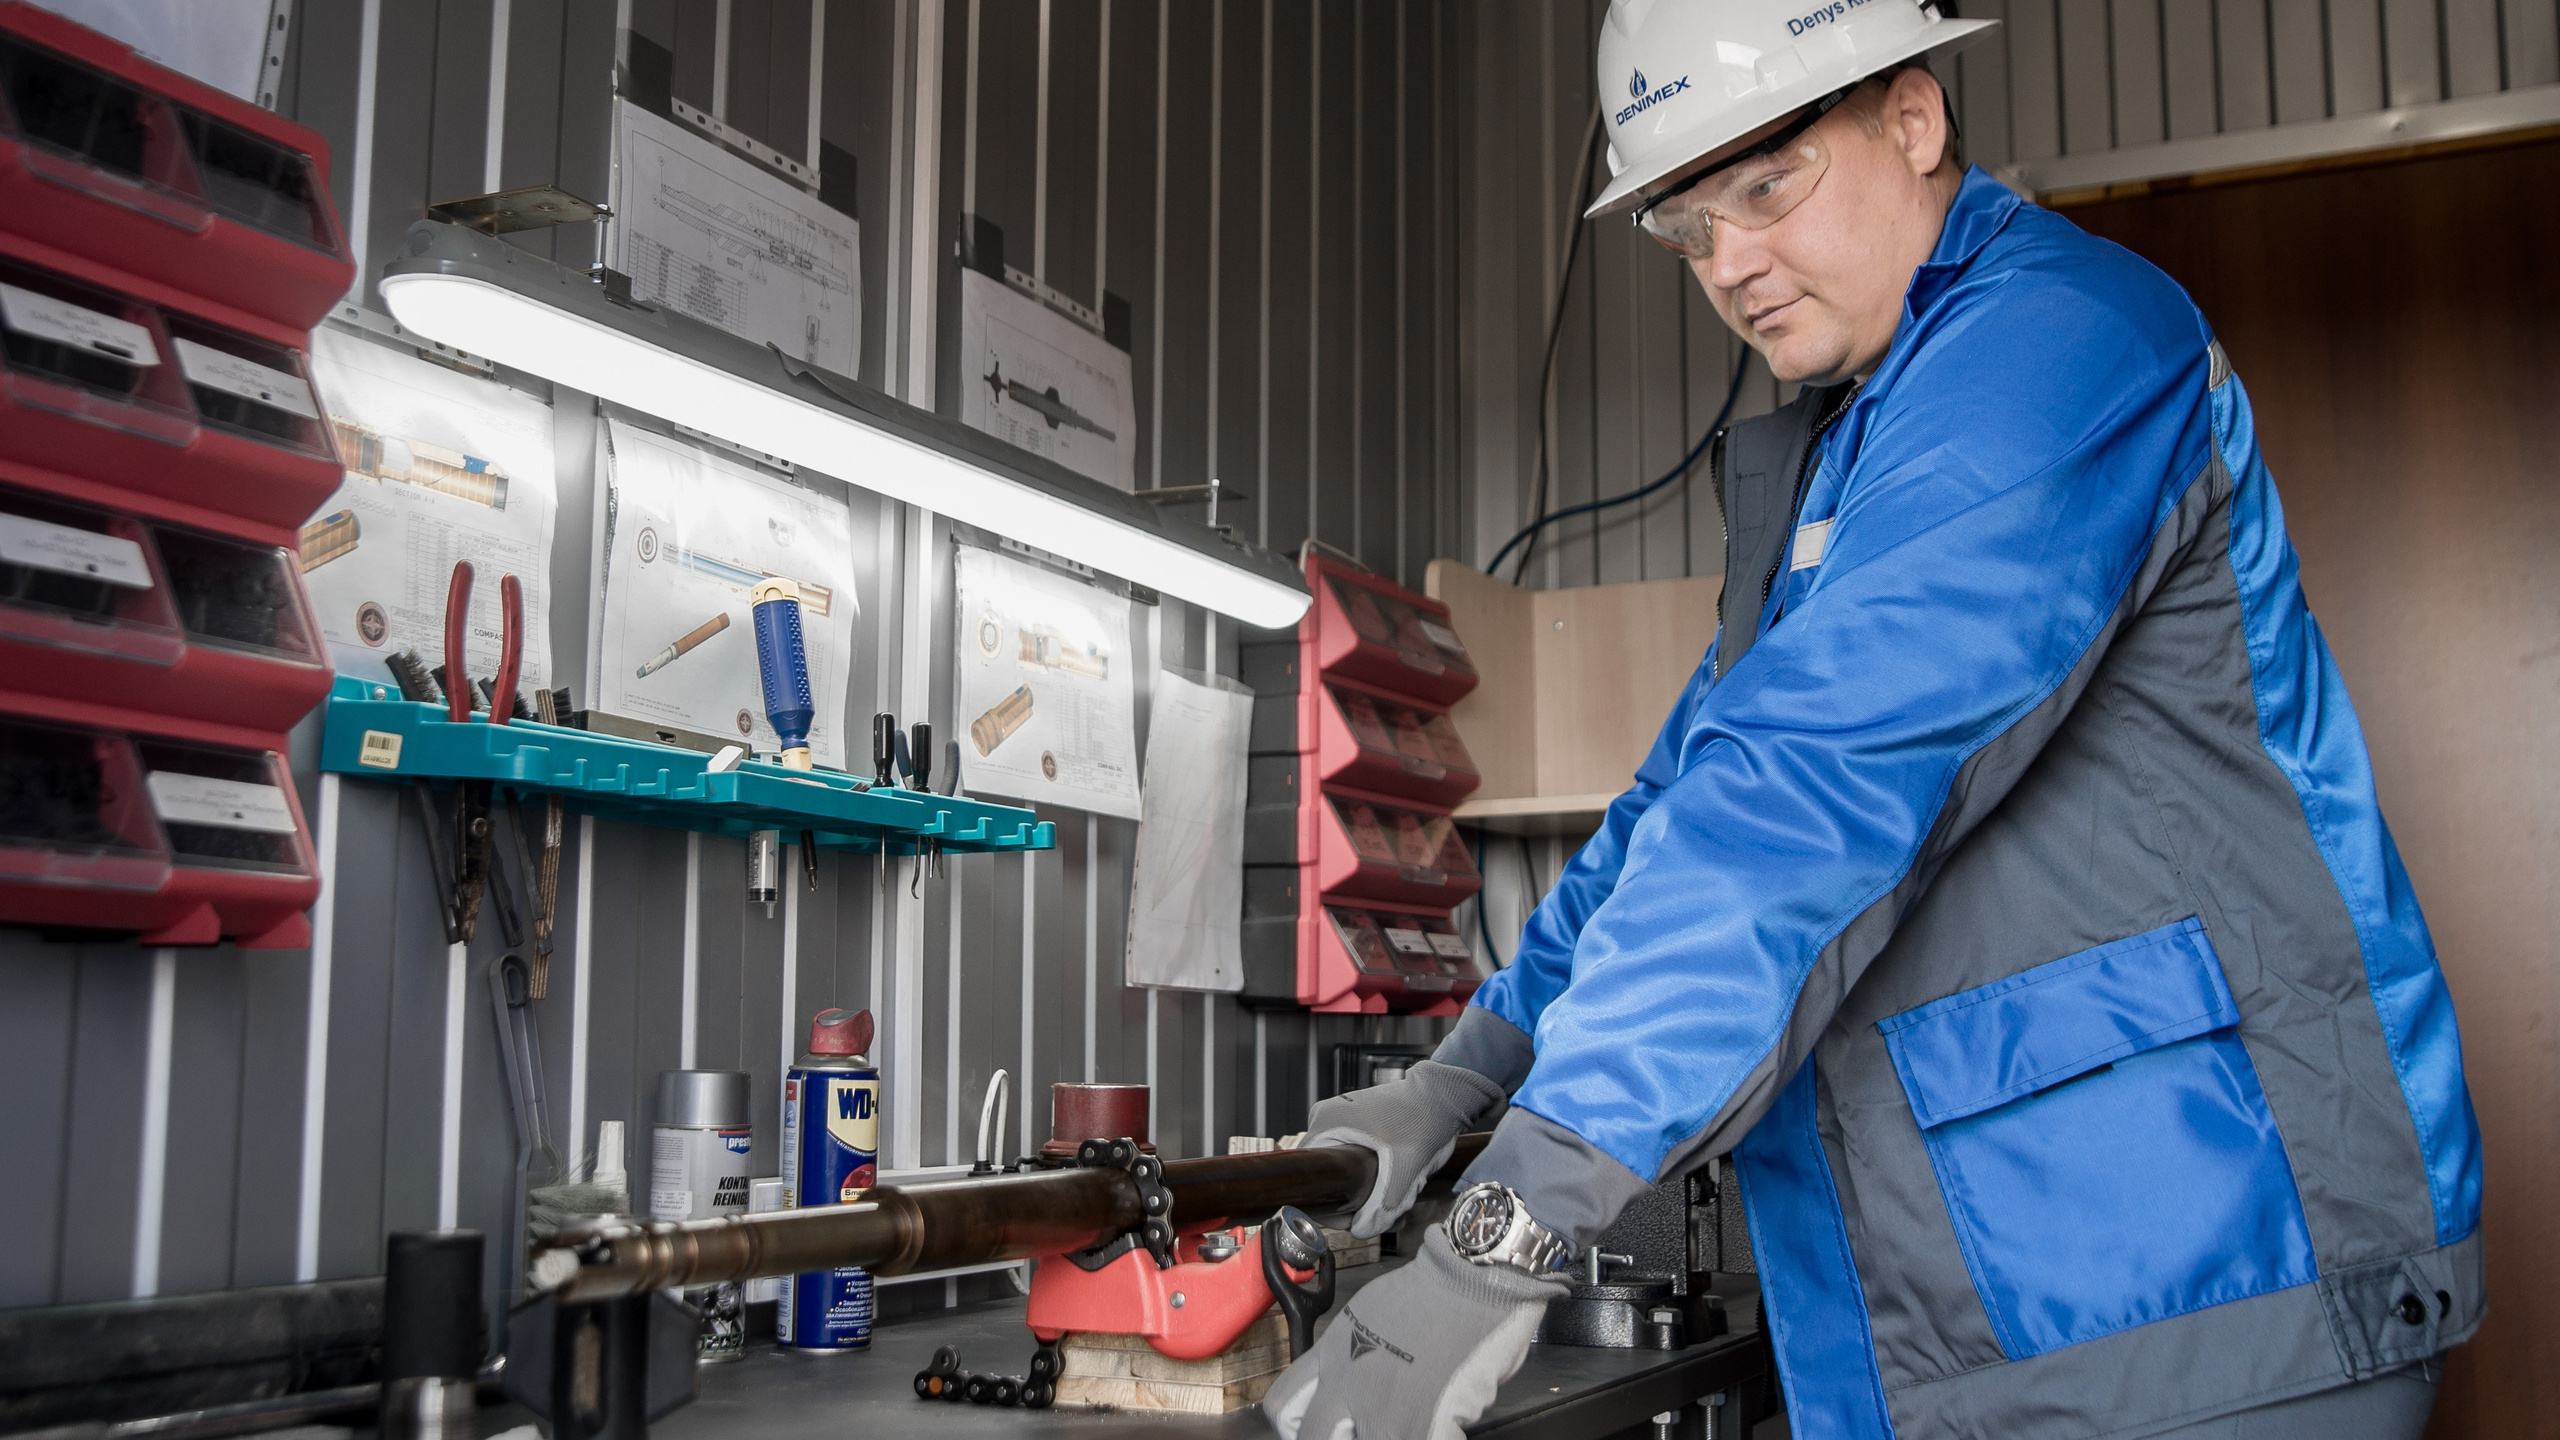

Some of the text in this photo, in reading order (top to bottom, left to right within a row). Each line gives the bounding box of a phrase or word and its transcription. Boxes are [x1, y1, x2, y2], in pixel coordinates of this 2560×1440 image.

[1787, 1, 1845, 36] Denys
[1615, 75, 1692, 127] DENIMEX
[1343, 1304, 1415, 1364] DELTAPLUS
